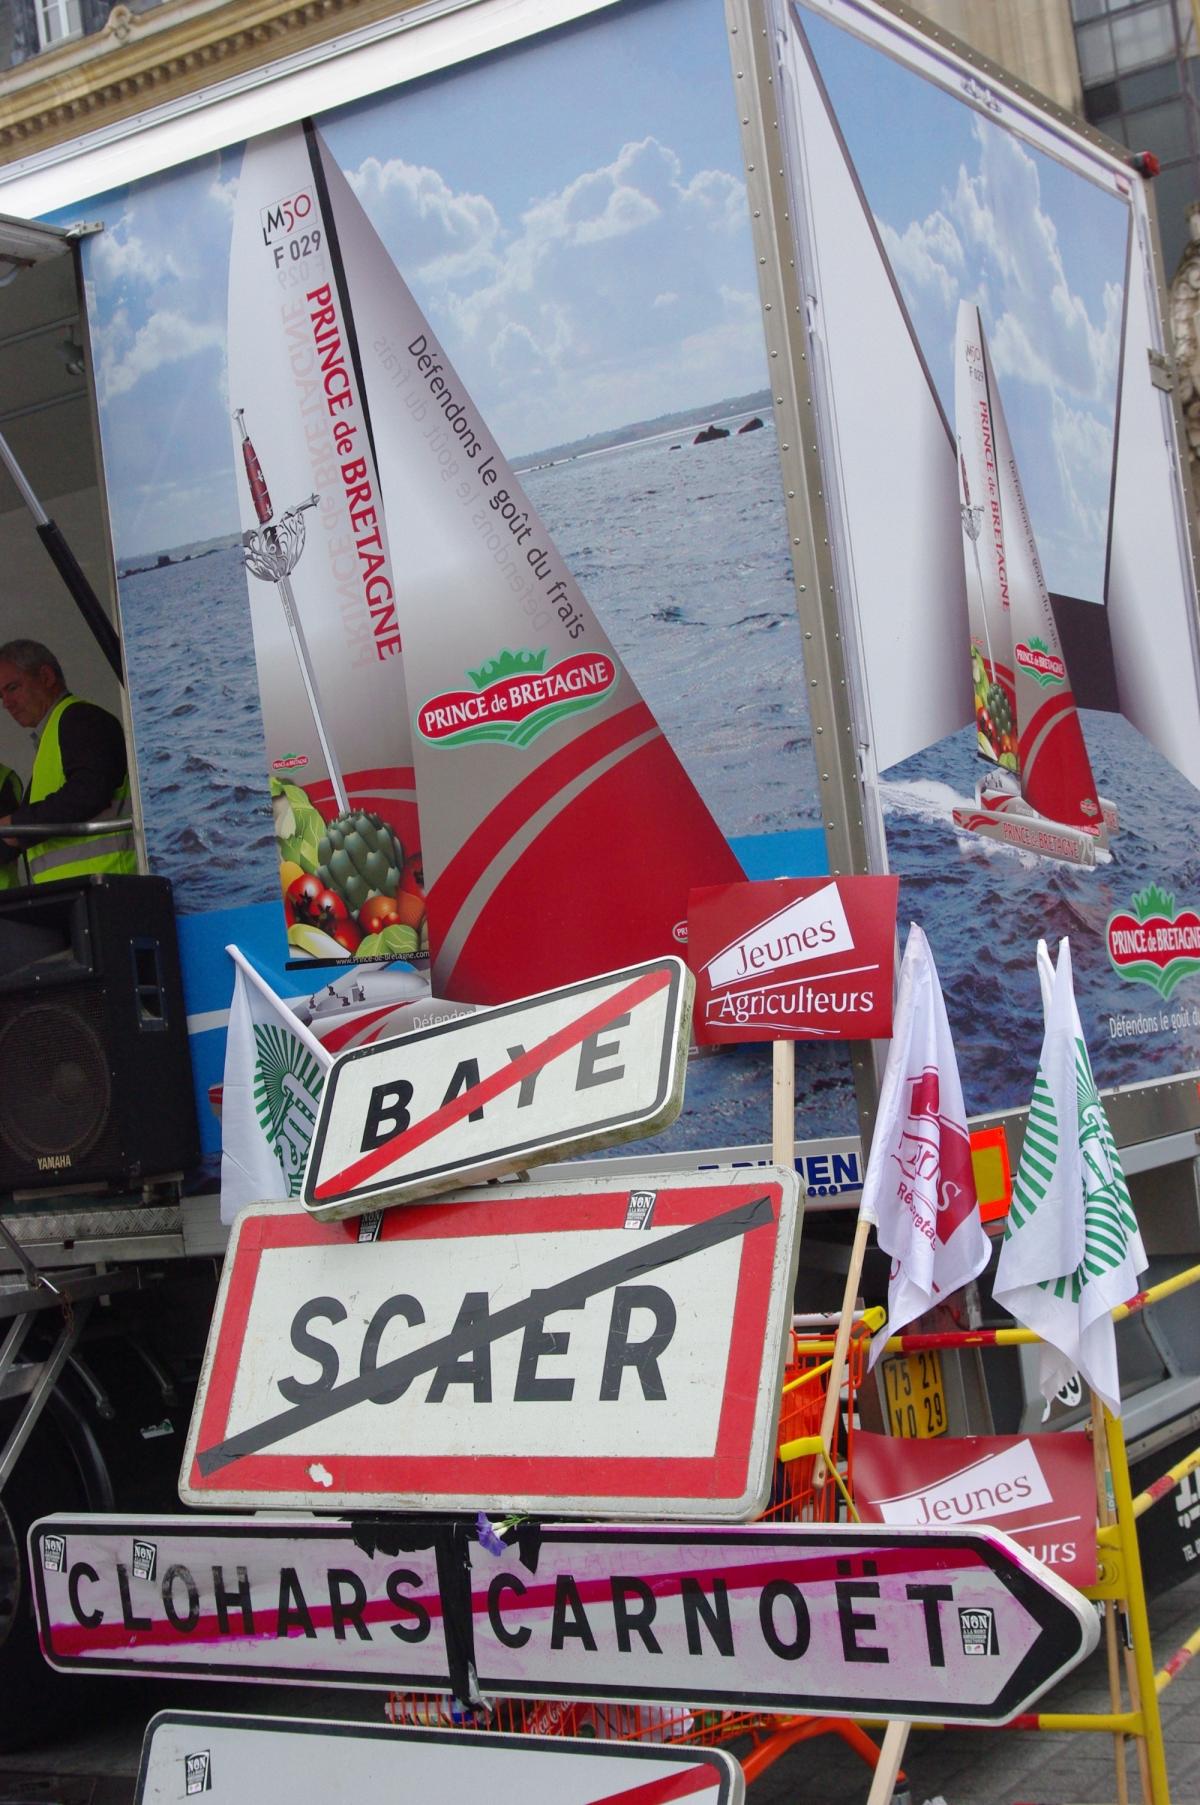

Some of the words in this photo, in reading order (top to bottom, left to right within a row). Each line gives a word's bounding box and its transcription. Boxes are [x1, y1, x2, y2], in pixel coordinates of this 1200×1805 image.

[273, 246, 284, 269] F
[289, 230, 321, 261] 029
[306, 282, 354, 417] PRINCE
[333, 420, 357, 456] de
[407, 334, 482, 458] Défendons
[477, 455, 498, 486] le
[488, 489, 532, 546] goût
[526, 547, 551, 580] du
[546, 580, 585, 640] frais
[979, 400, 995, 473] PRINCE
[990, 499, 1010, 612] BRETAGNE
[341, 455, 402, 661] BRETAGNE
[424, 696, 489, 732] PRINCE
[490, 696, 508, 714] de
[508, 661, 609, 709] BRETAGNE
[736, 919, 836, 976] Jeunes
[1111, 930, 1147, 955] PRINCE
[1147, 930, 1157, 953] de
[718, 985, 874, 1023] Agriculteurs
[1109, 1012, 1158, 1039] Défendons
[1159, 1010, 1169, 1031] le
[1171, 1006, 1190, 1034] goût
[359, 1011, 632, 1154] BAYE
[37, 1154, 72, 1170] YAMAHA
[630, 1196, 651, 1208] NON
[276, 1284, 677, 1405] SCAER
[916, 1475, 1032, 1525] Jeunes
[45, 1539, 62, 1551] NON
[134, 1545, 152, 1560] NON
[67, 1560, 432, 1643] CLOHARS
[486, 1559, 954, 1667] CARNOËT
[961, 1615, 988, 1629] NON
[187, 1756, 206, 1773] NON
